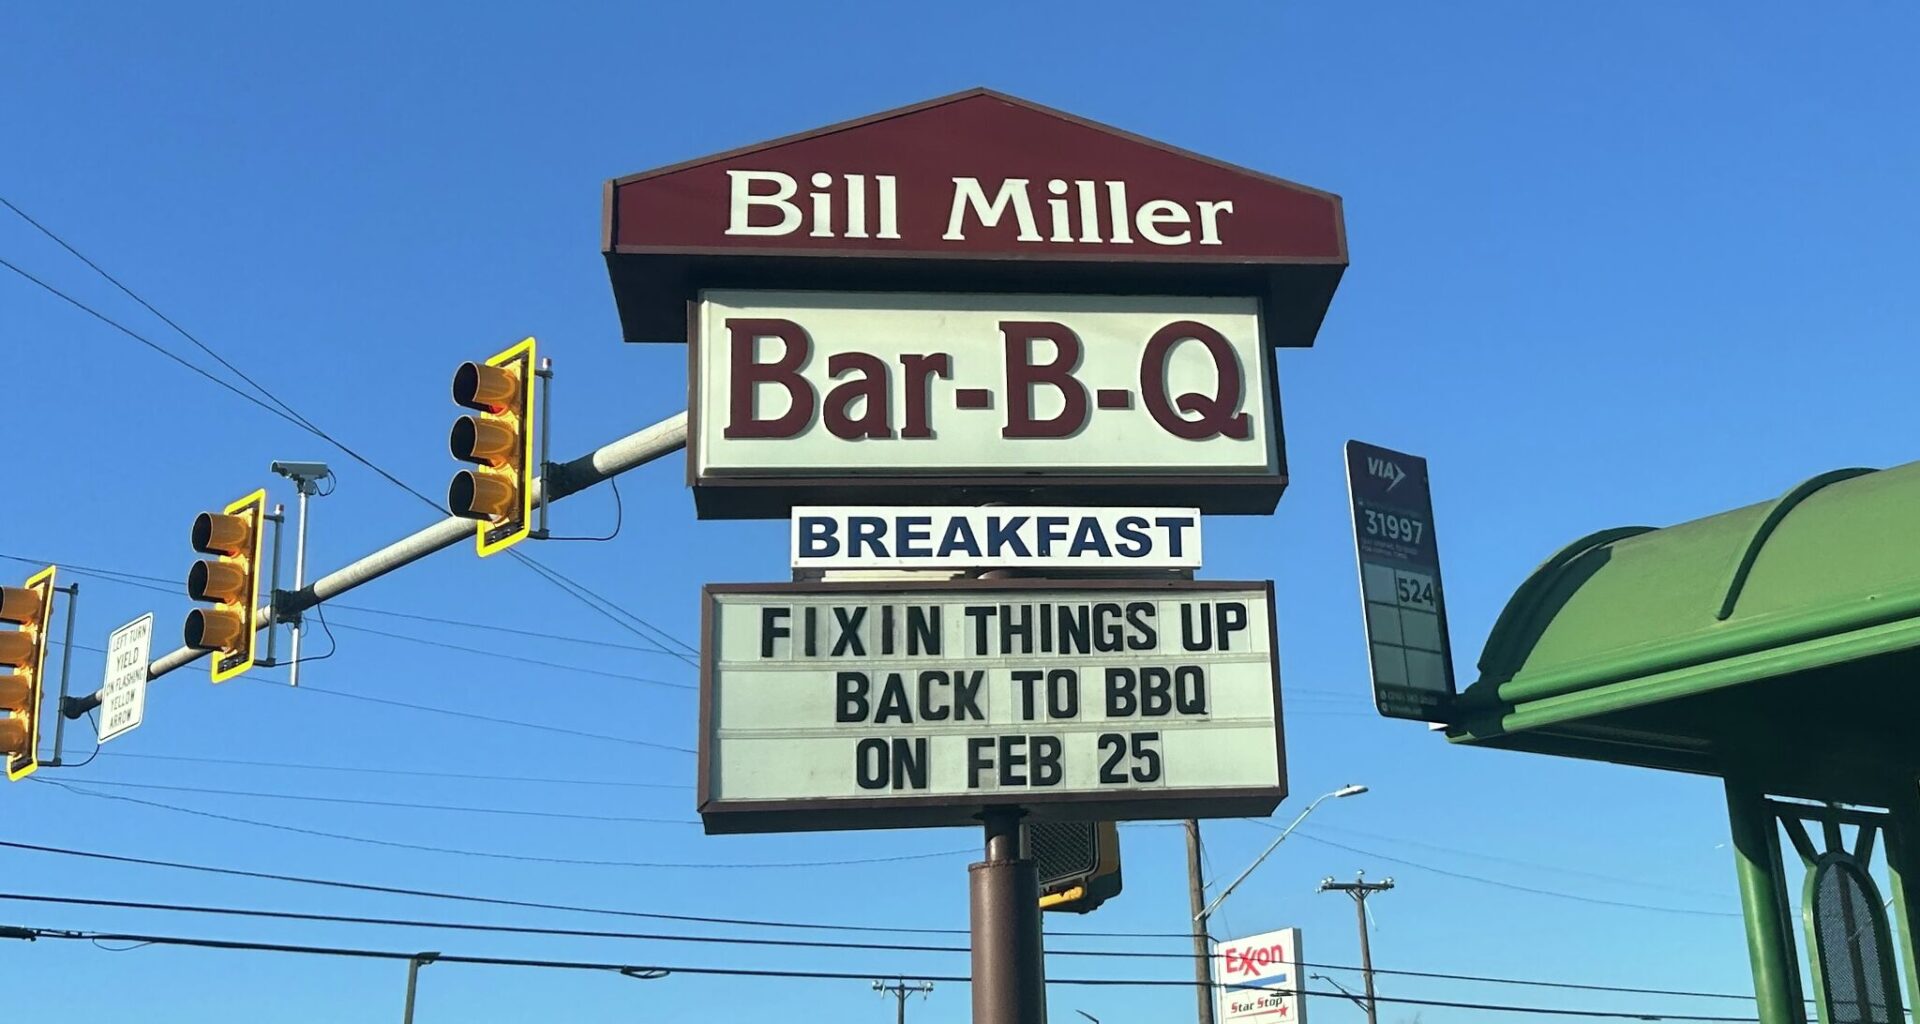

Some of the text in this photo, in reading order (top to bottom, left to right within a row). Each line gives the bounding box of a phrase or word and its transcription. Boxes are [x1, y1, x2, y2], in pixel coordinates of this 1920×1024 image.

[724, 169, 1234, 246] Bill Miller
[723, 317, 1252, 441] Bar-B-Q
[1367, 457, 1395, 480] VIA
[799, 515, 1195, 559] BREAKFAST
[1365, 509, 1422, 544] 31997
[1398, 578, 1435, 607] 524
[113, 624, 147, 652] LEFT TURN
[761, 602, 1247, 658] FIXIN THINGS UP
[116, 647, 139, 672] YIELD
[105, 667, 144, 696] ON FLASHING
[836, 665, 1209, 724] BACK TO BBQ
[110, 688, 135, 711] YELLOW
[110, 708, 132, 729] ARROW
[856, 731, 1161, 790] ON FEB 25
[1225, 945, 1283, 976] Exxon
[1231, 997, 1283, 1013] Star Stop
